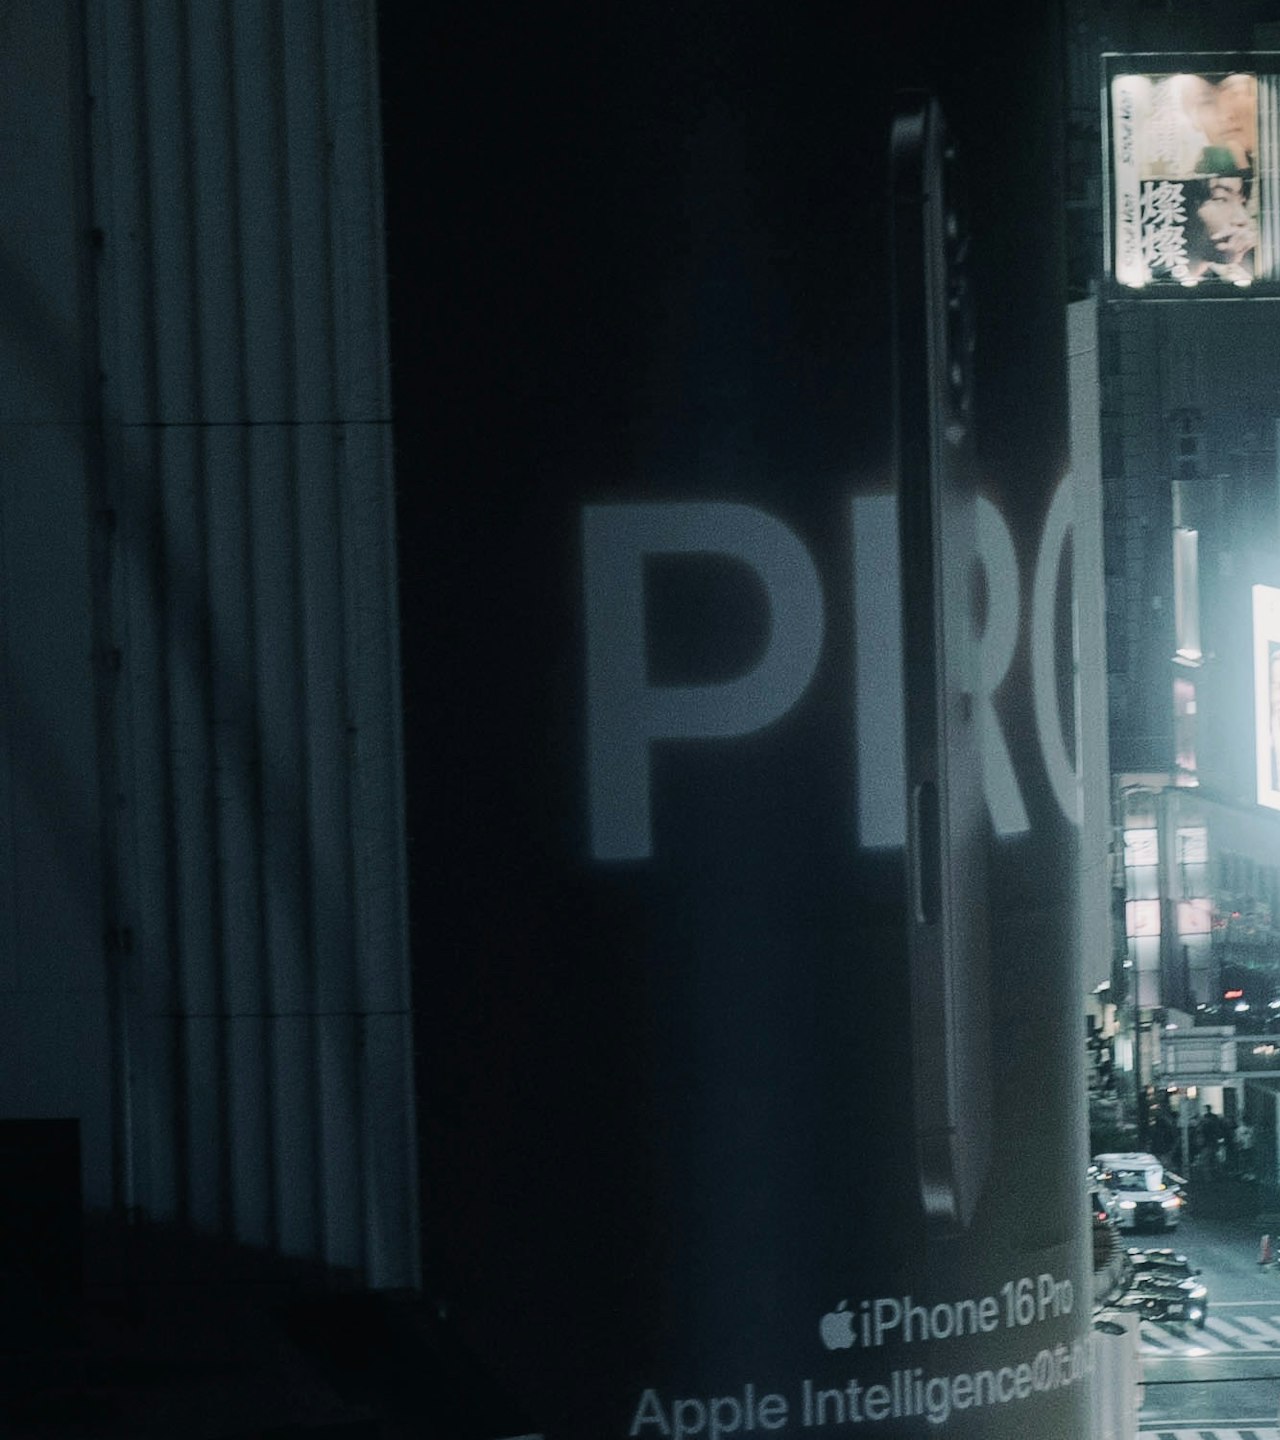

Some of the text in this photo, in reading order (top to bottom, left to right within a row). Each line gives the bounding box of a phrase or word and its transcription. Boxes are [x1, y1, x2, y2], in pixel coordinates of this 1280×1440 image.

[860, 1273, 1074, 1349] iPhone 16 Pro
